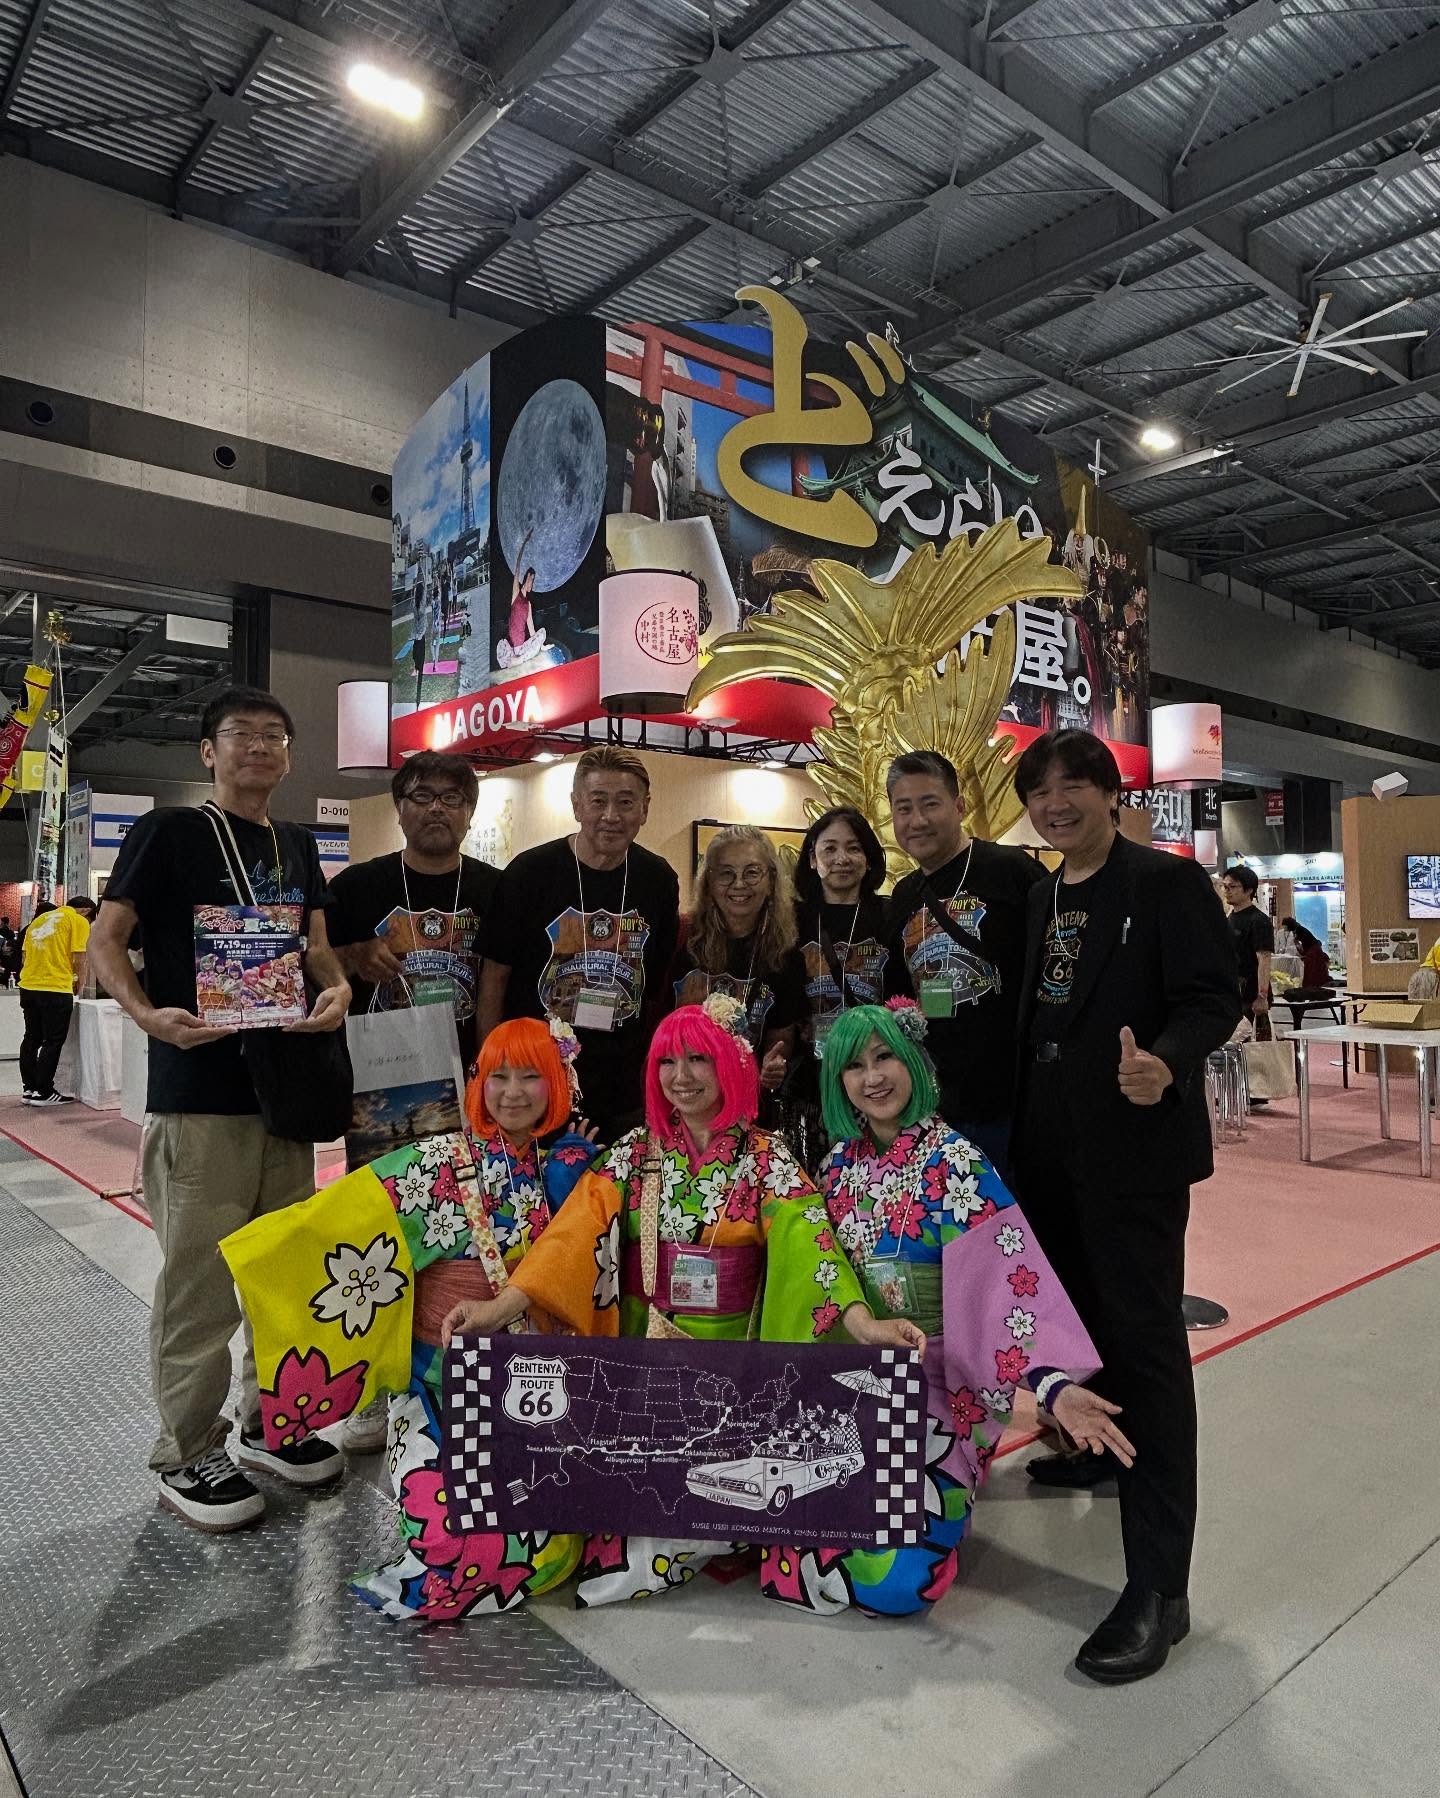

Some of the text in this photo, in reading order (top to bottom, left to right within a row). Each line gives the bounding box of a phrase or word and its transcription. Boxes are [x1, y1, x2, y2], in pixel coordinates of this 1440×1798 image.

[640, 620, 650, 643] 中村
[665, 607, 681, 659] 名古屋
[433, 685, 544, 749] NAGOYA
[1206, 788, 1217, 810] 北
[321, 806, 349, 816] D-010
[427, 927, 438, 935] 66
[595, 928, 606, 936] 66
[513, 1362, 563, 1375] BENTENYA
[520, 1379, 555, 1390] ROUTE
[519, 1390, 553, 1417] 66
[699, 1399, 726, 1407] Chicago
[726, 1420, 760, 1429] Springfield
[684, 1449, 717, 1457] Oklahoma
